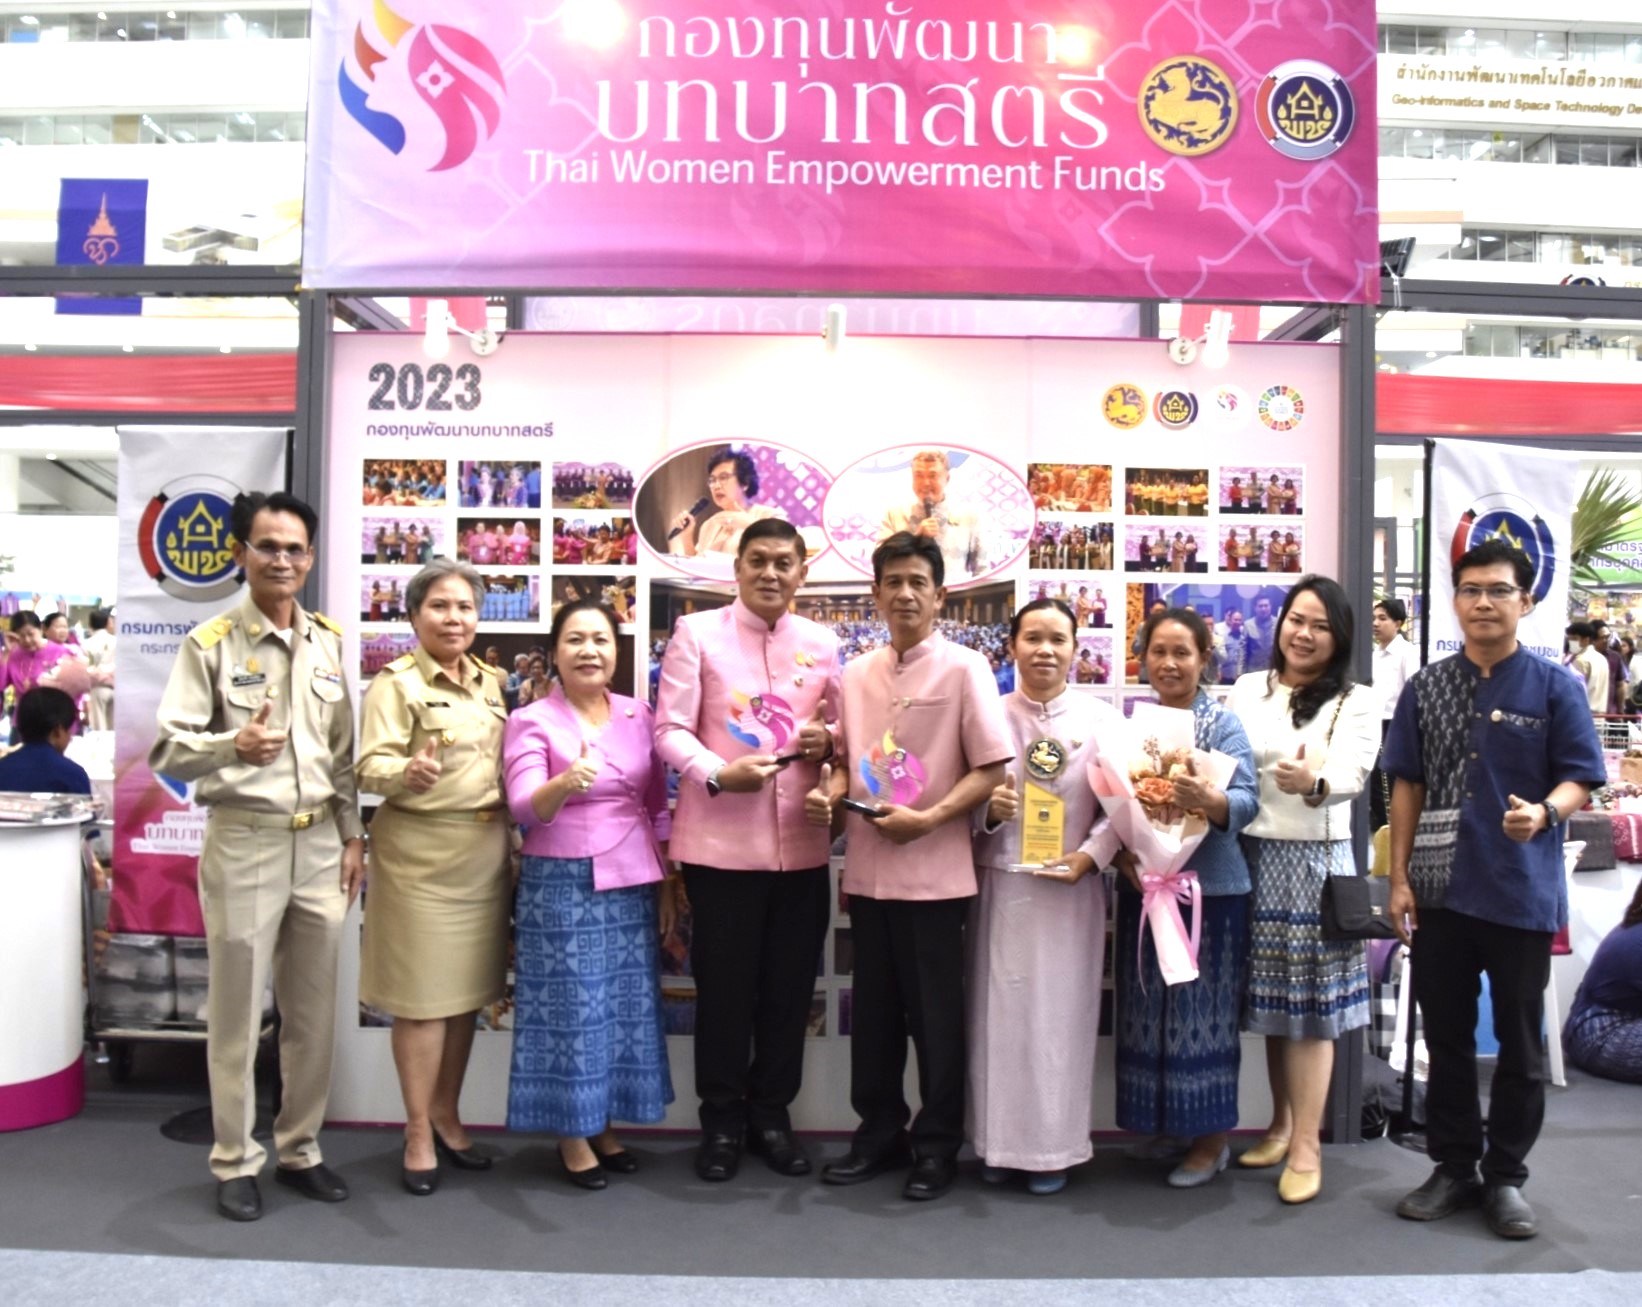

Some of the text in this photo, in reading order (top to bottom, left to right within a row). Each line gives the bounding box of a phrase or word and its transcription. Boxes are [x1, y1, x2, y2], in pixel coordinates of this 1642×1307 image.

[638, 1, 1057, 77] กองทุนพัฒนา
[596, 65, 1109, 149] บทบาทสตรี
[1488, 97, 1510, 109] and
[1514, 98, 1551, 113] Space
[1556, 100, 1624, 117] Technology
[523, 149, 1166, 194] Thai Women Empowerment Funds
[368, 362, 482, 411] 2023
[366, 420, 554, 440] กองทุนพัฒนาบทบาทสตรี
